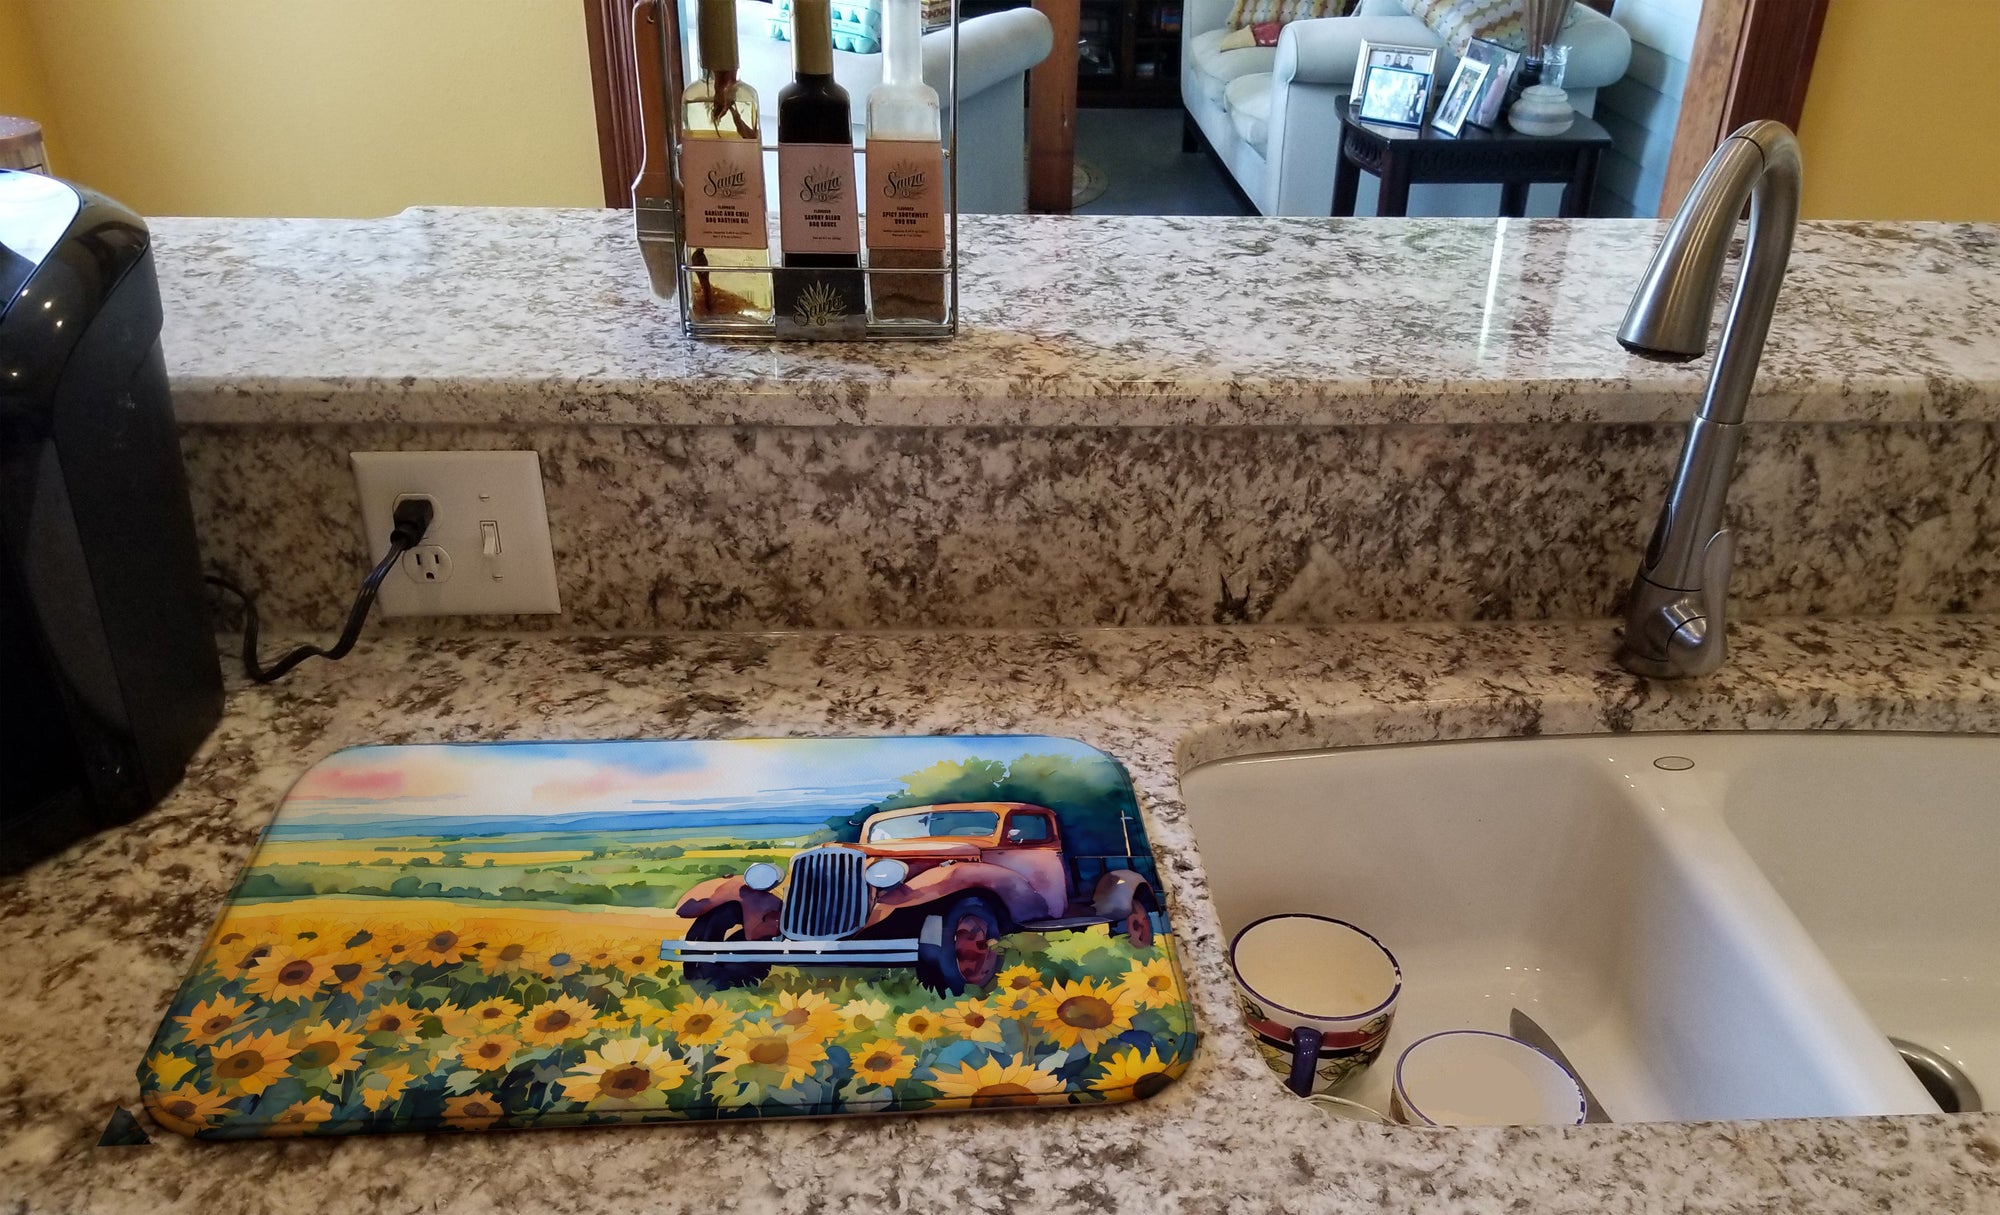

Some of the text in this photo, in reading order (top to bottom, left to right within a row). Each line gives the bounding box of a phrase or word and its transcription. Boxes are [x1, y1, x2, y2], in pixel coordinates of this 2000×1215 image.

[704, 170, 746, 197] Sauza
[800, 175, 842, 202] Sauza
[884, 172, 926, 198] Sauza
